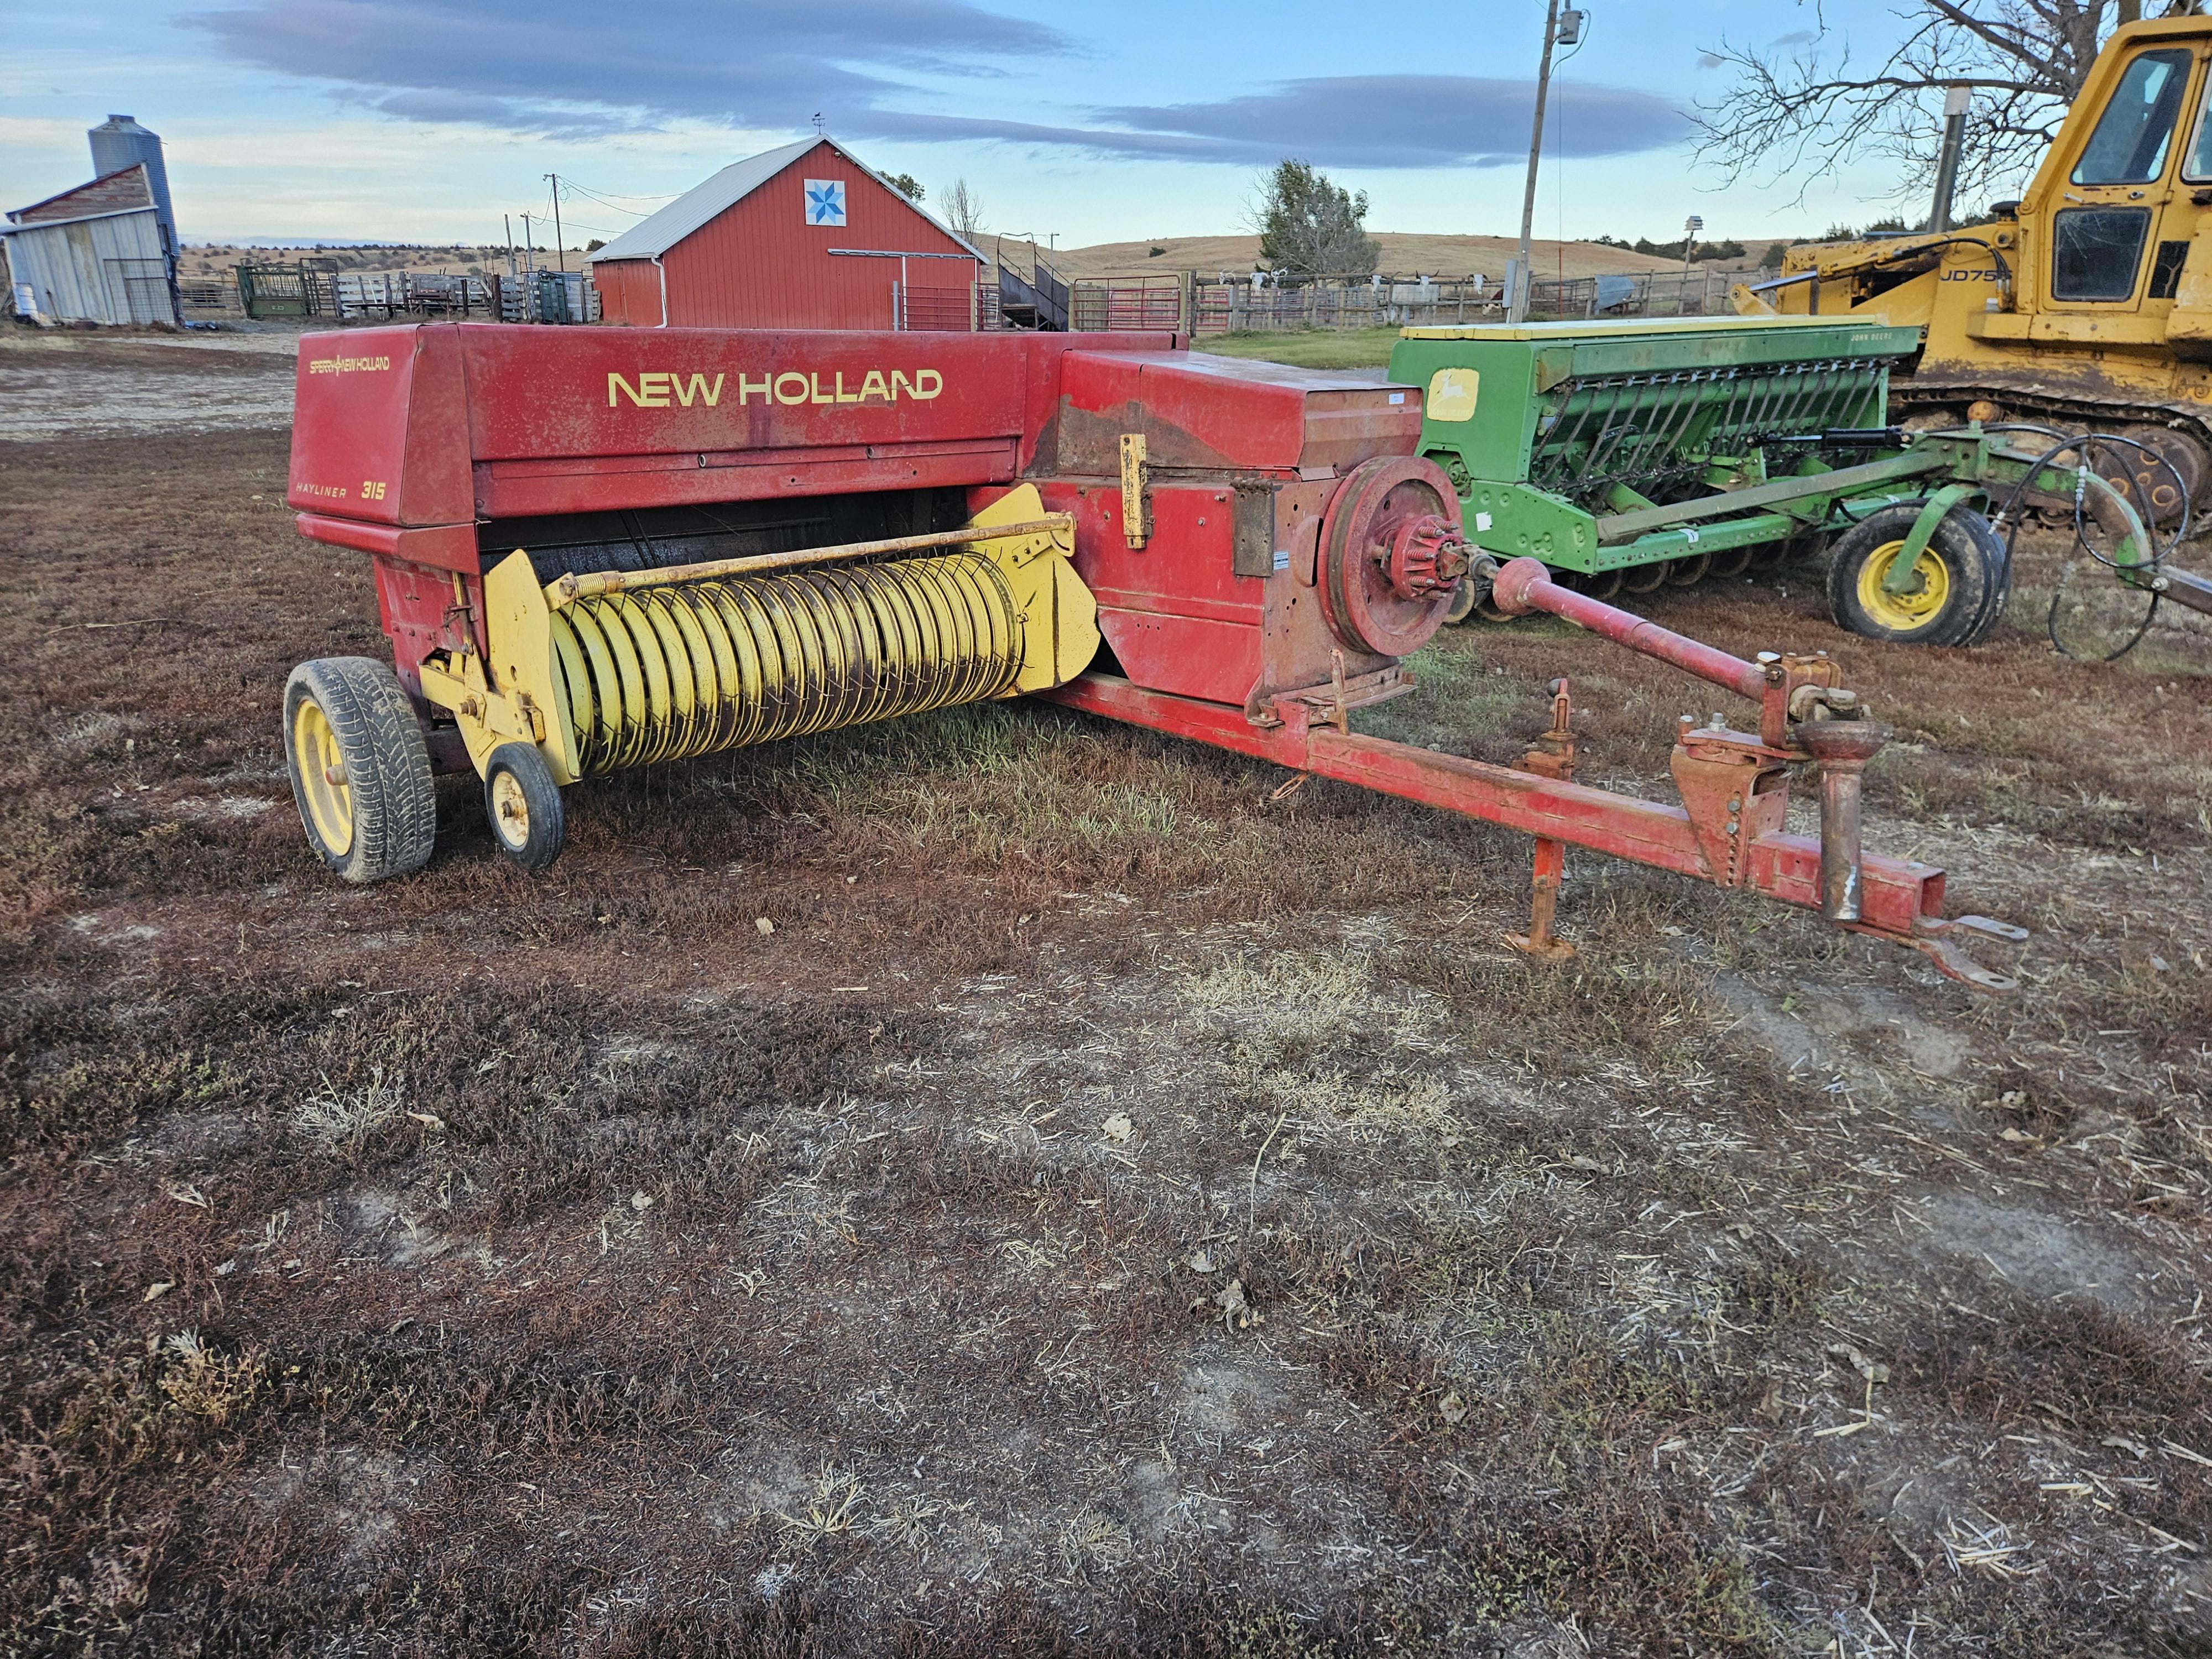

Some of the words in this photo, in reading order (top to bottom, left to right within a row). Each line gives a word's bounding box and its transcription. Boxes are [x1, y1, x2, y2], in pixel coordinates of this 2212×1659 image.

[310, 360, 336, 374] SPERRY
[341, 358, 357, 372] NEW
[357, 356, 390, 372] HOLLAND
[608, 373, 724, 408] NEW
[739, 369, 943, 406] HOLLAND
[296, 482, 347, 499] HAYLINER
[361, 481, 387, 500] 315
